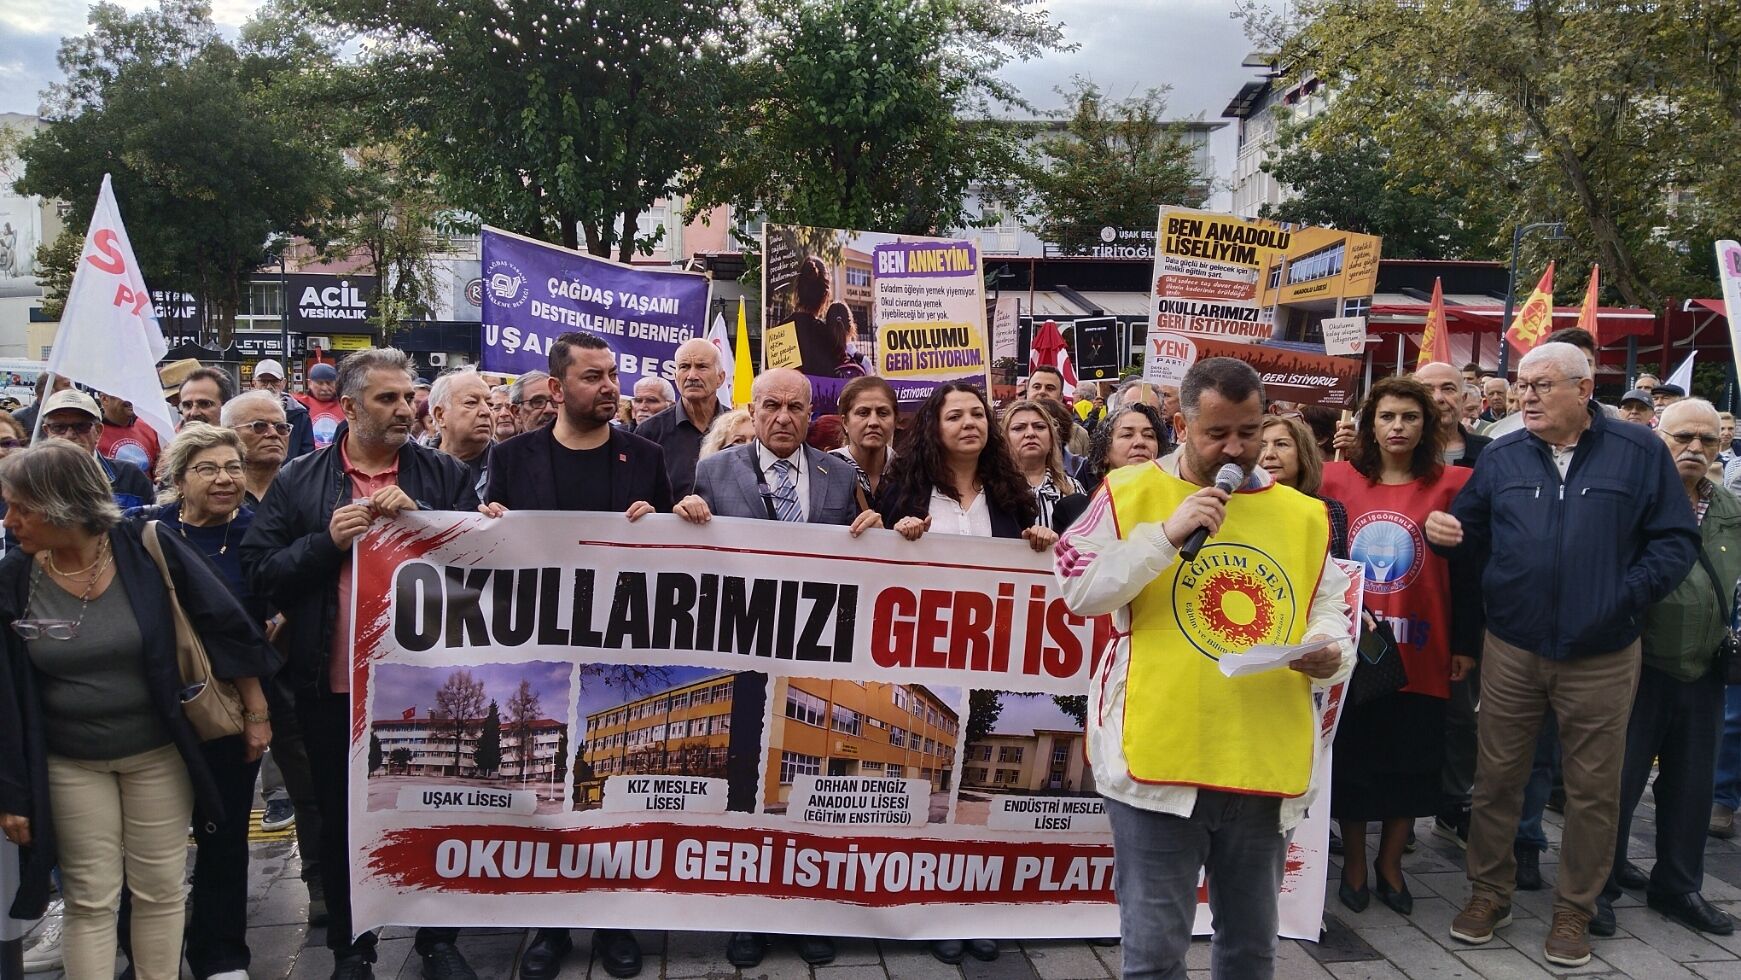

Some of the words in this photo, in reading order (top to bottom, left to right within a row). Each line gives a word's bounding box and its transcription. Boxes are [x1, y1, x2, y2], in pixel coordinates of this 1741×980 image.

[1168, 218, 1203, 238] BEN
[1205, 222, 1290, 250] ANADOLU
[878, 250, 905, 273] BEN
[908, 246, 974, 273] ANNEYİM.
[1092, 243, 1156, 258] TİRİTOĞL
[1165, 236, 1260, 265] LİSELİYİM.
[1180, 259, 1199, 268] güçlü
[1199, 261, 1209, 269] bir
[1209, 264, 1235, 272] gelecek
[1236, 267, 1248, 276] için
[1185, 268, 1207, 277] eğitim
[299, 281, 366, 307] ACİL
[547, 276, 614, 311] ÇAĞDAŞ
[618, 292, 680, 316] YAŞAMI
[926, 287, 945, 296] yemek
[880, 297, 894, 307] Okul
[923, 299, 942, 309] yemek
[1158, 299, 1260, 322] OKULLARIMIZI
[299, 306, 366, 320] VESİKALIK
[917, 310, 925, 319] bir
[926, 312, 936, 320] yer
[531, 300, 624, 336] DESTEKLEME
[628, 319, 694, 345] DERNEĞİ
[1157, 313, 1186, 330] GERİ
[1189, 315, 1273, 338] İSTİYORUM
[886, 327, 969, 350] OKULUMU
[1152, 338, 1189, 360] YENİ
[886, 349, 913, 372] GERİ
[916, 348, 984, 369] İSTİYORUM.
[1262, 372, 1288, 382] GERİ
[1288, 373, 1339, 387] İSTİYORUZ
[1182, 552, 1248, 589] EĞİTİM
[1255, 563, 1287, 601] SEN
[394, 562, 859, 662] OKULLARIMIZI
[870, 582, 1015, 673] GERİ
[627, 779, 650, 794] KIZ
[654, 780, 707, 796] MESLEK
[814, 778, 859, 793] ORHAN
[862, 777, 907, 794] DENGİZ
[422, 791, 464, 808] UŞAK
[467, 790, 512, 809] LİSESİ
[645, 794, 685, 811] LİSESİ
[808, 794, 867, 809] ANADOLU
[870, 794, 909, 810] LİSESİ
[1004, 797, 1059, 814] ENDÜSTRİ
[803, 808, 847, 824] (EĞİTİM
[849, 809, 912, 826] ENSTİTÜSÜ)
[1034, 815, 1071, 830] LİSESİ
[434, 838, 664, 880] OKULUMU
[675, 837, 773, 883] GERİ
[782, 838, 1005, 892] İSTİYORUM
[1012, 856, 1115, 892] PLAT
